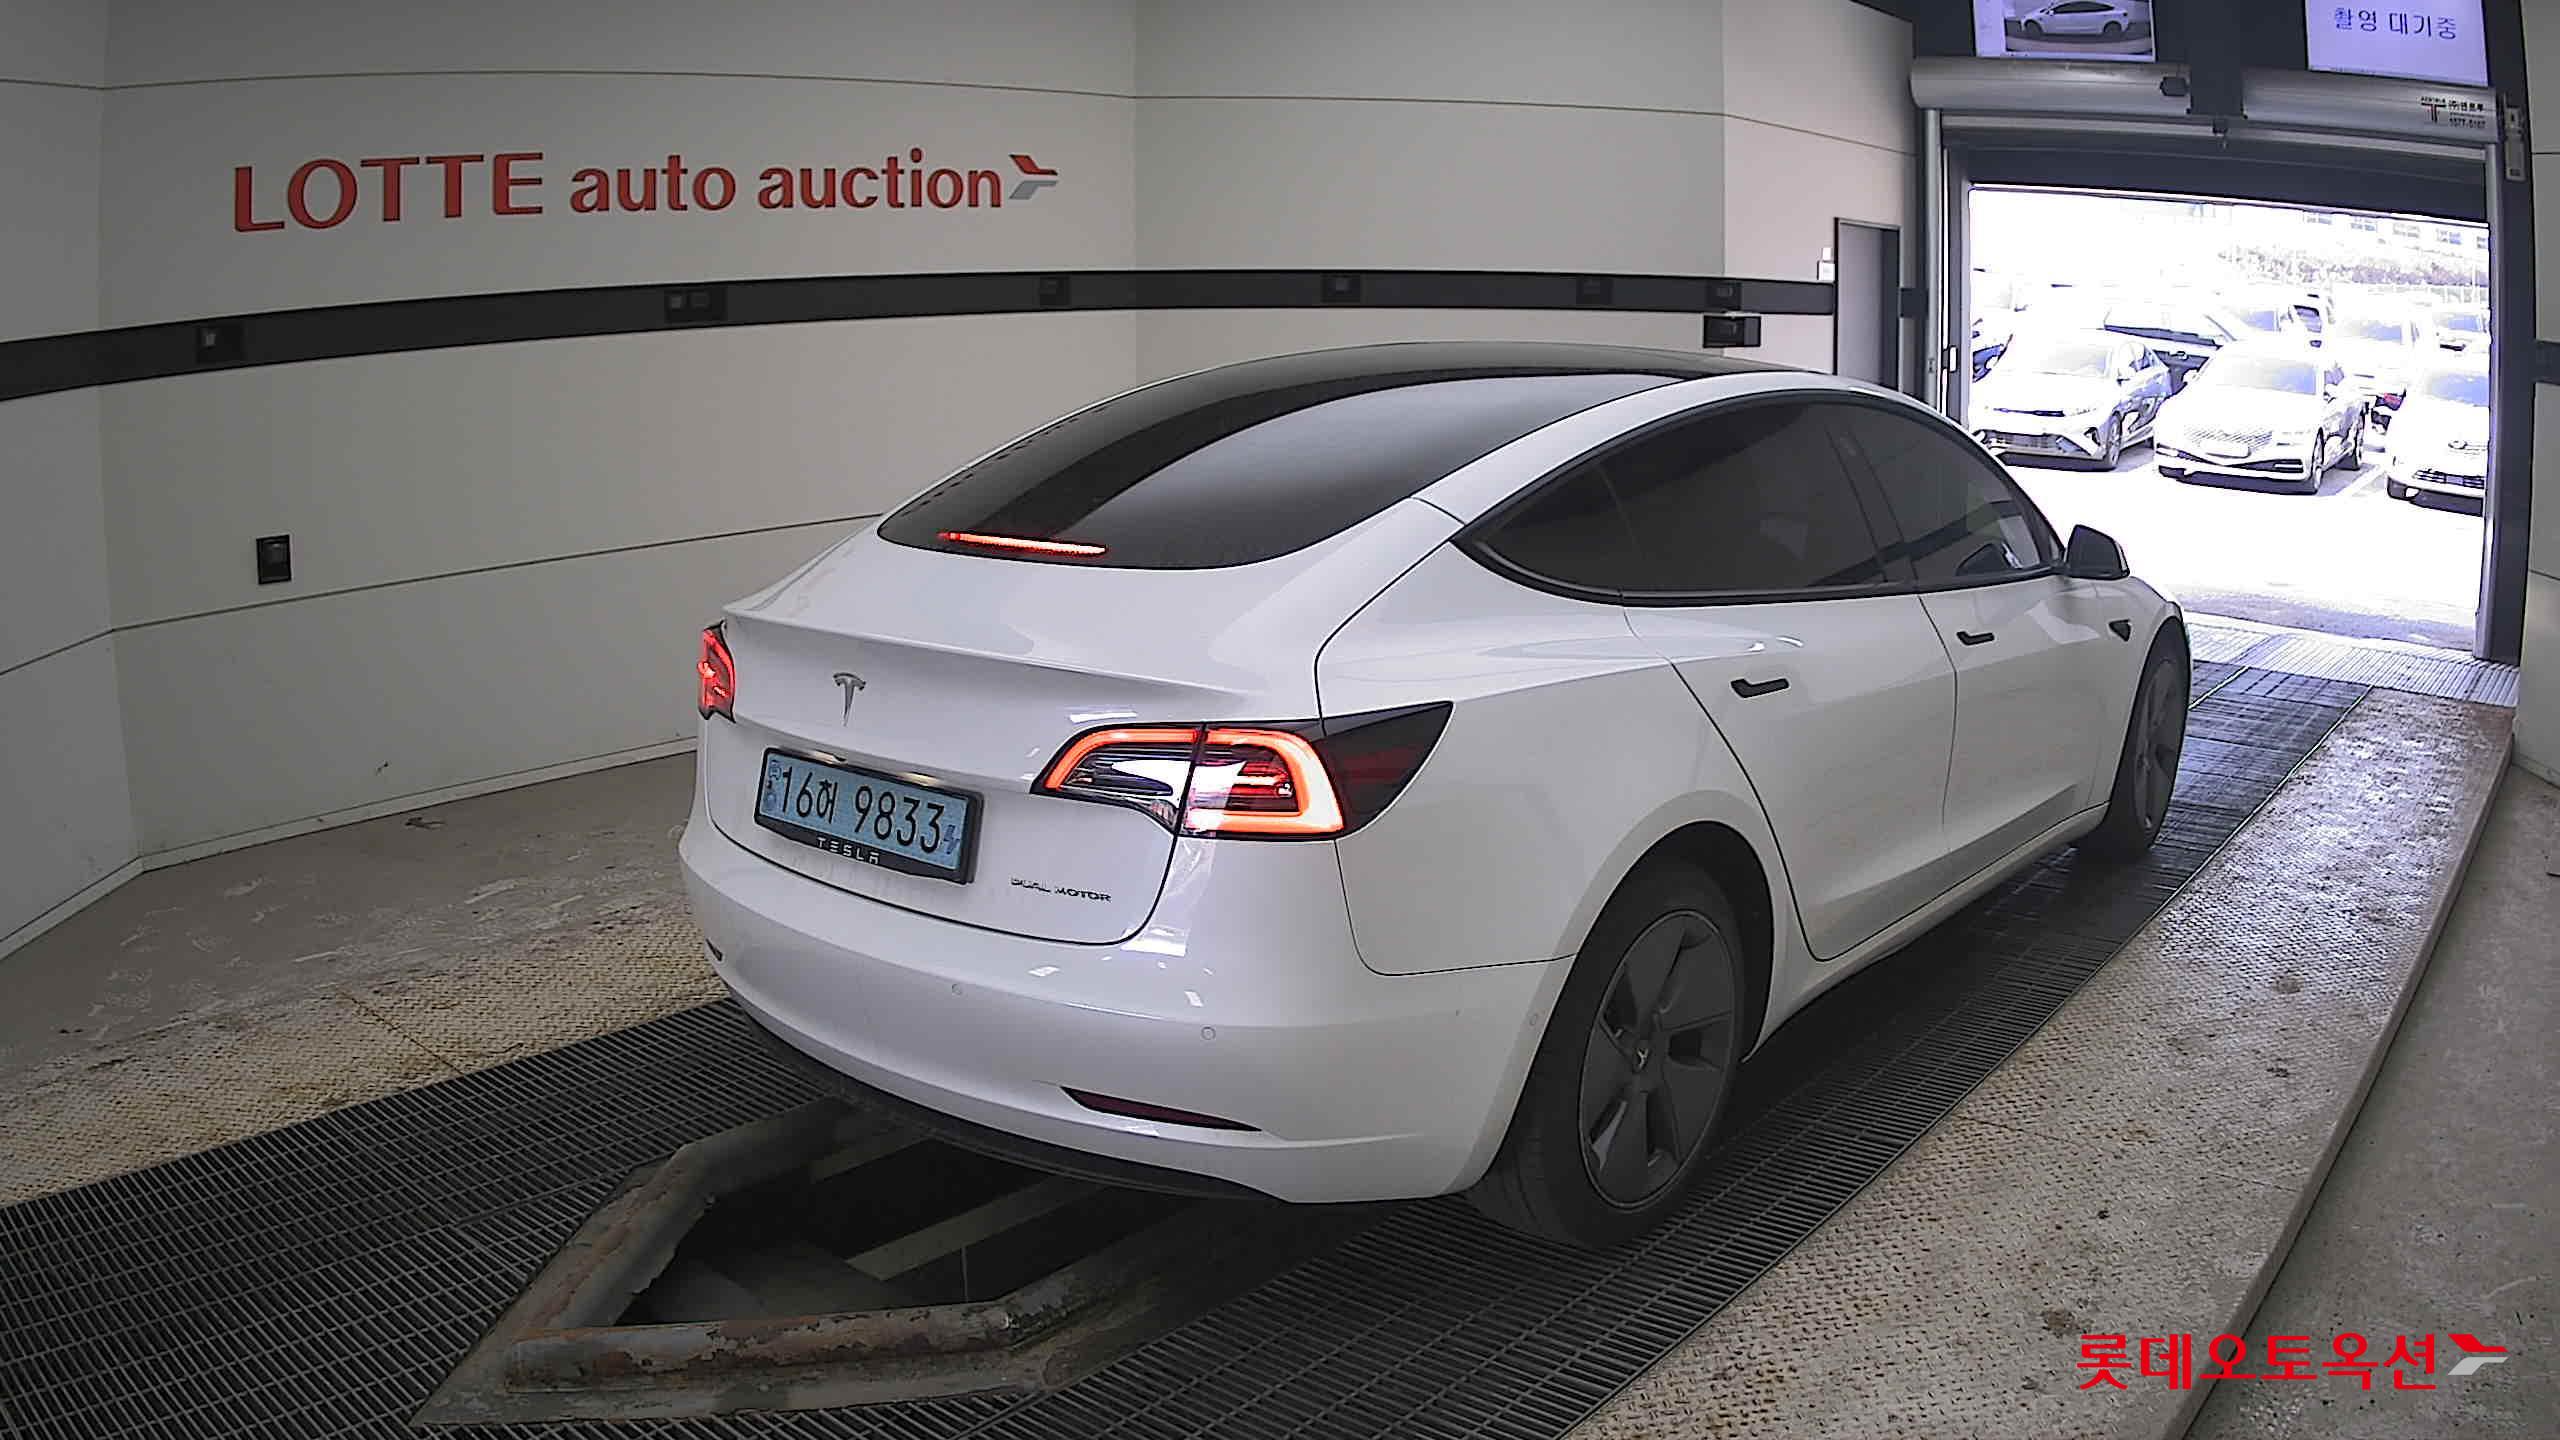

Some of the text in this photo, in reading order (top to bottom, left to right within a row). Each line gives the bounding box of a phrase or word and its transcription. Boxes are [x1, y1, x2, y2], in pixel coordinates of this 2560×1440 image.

[2389, 13, 2457, 40] 대기중
[234, 148, 1002, 232] LOTTE auto auction
[854, 785, 944, 854] 9833
[816, 836, 880, 865] TESLA
[1054, 887, 1112, 902] MOTOR
